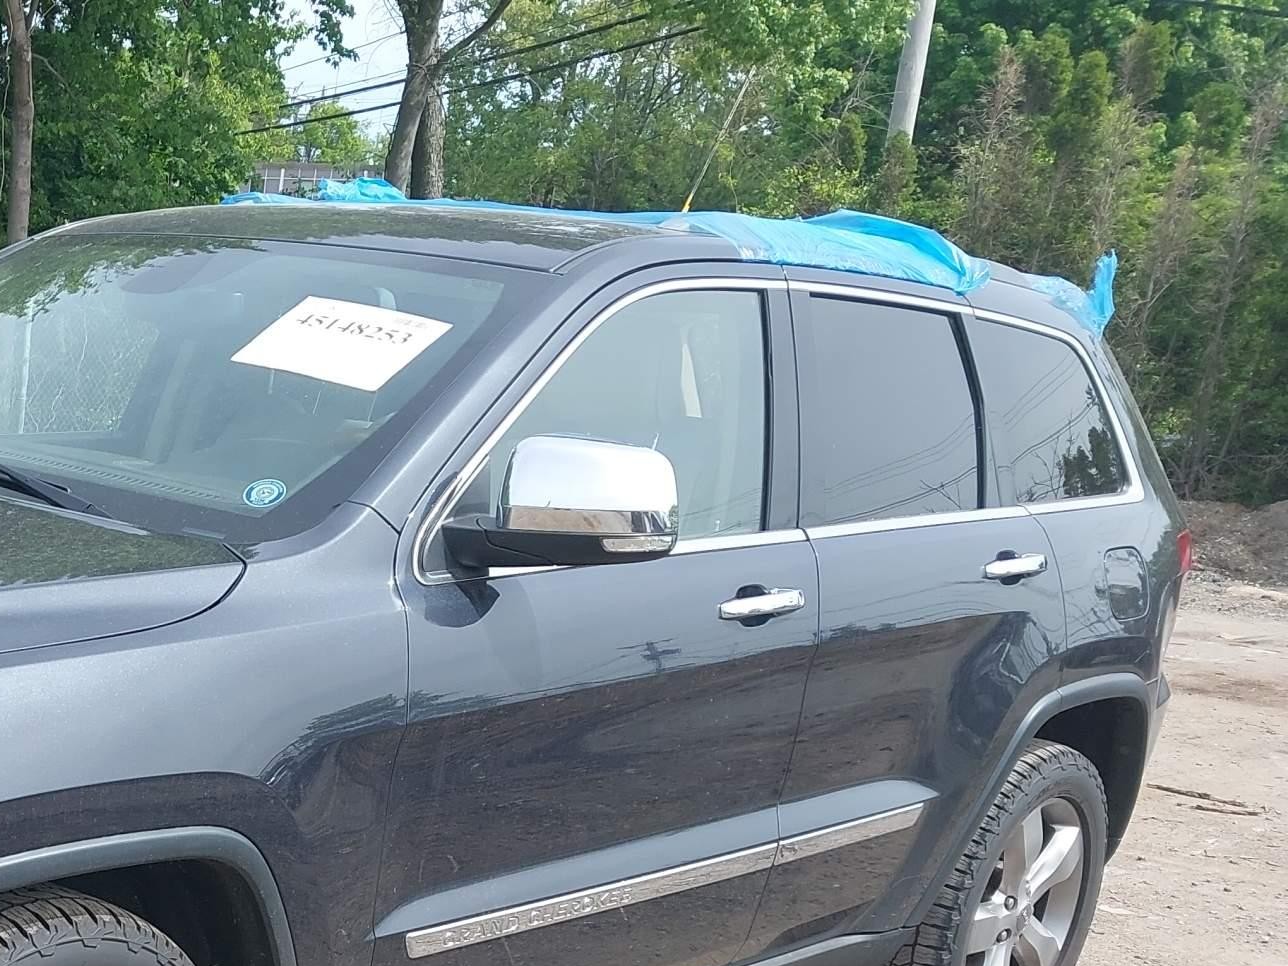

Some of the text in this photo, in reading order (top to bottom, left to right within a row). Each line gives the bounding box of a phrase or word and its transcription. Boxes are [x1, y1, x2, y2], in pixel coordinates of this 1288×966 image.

[296, 313, 413, 344] 45148253
[441, 887, 634, 948] GRAND CHEROKEE
